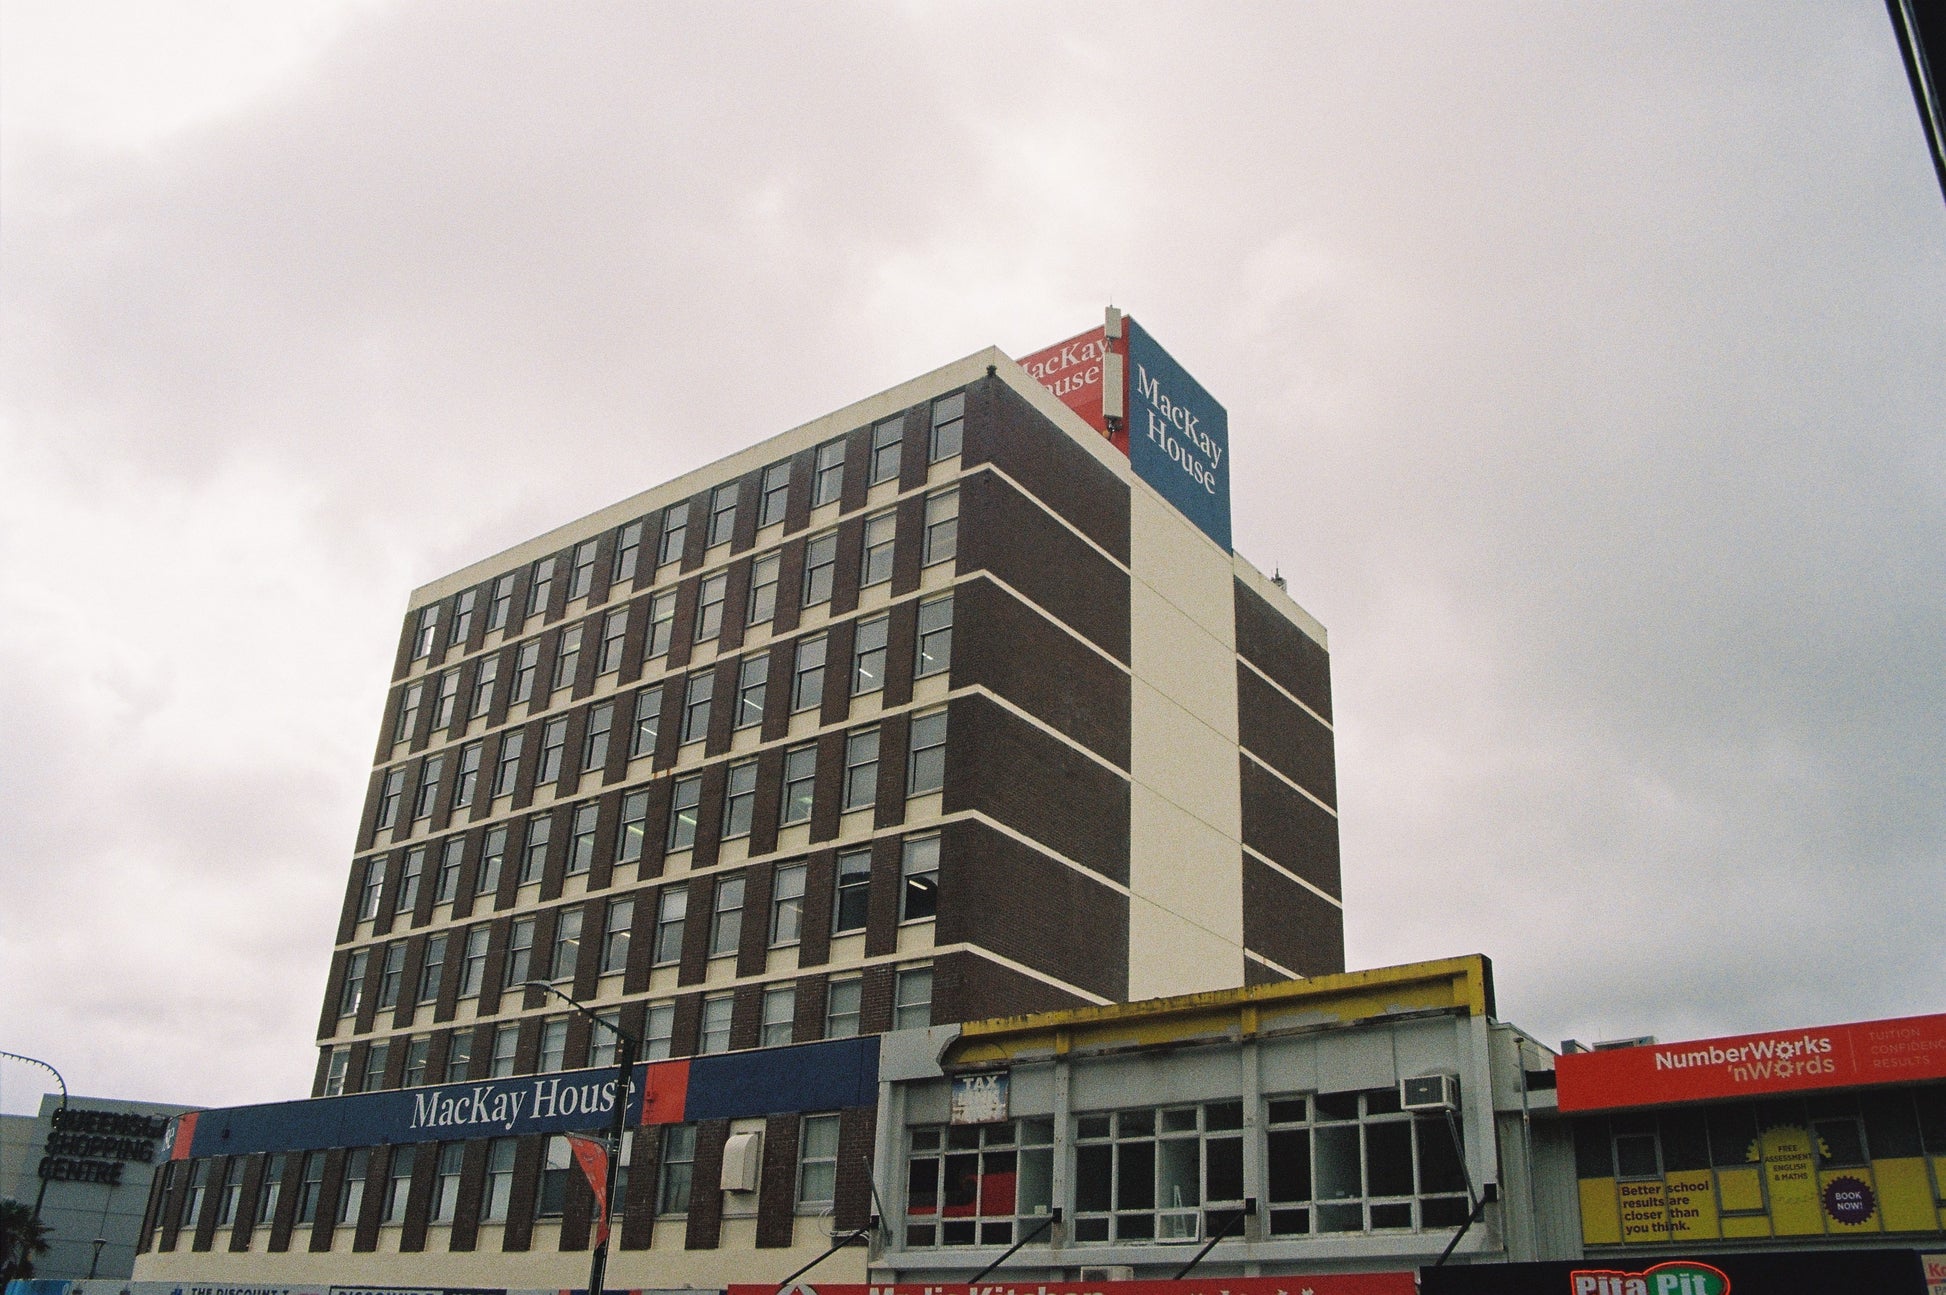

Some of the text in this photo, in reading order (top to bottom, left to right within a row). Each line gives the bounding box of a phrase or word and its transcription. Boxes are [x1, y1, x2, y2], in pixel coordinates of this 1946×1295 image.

[1137, 363, 1222, 469] MacKay
[1147, 408, 1215, 494] House
[1655, 1035, 1832, 1070] NumberWorks
[1873, 1056, 1930, 1068] RESULTS
[963, 1075, 998, 1091] TAX
[409, 1086, 527, 1130] MacKay
[45, 1131, 155, 1163] SHOPPING
[1778, 1144, 1799, 1152] FREE
[38, 1156, 125, 1187] CENTRE
[1773, 1163, 1807, 1172] ENGLISH
[1782, 1172, 1808, 1180] MATHS
[1622, 1181, 1709, 1196] Better school
[1835, 1191, 1862, 1200] BOOK
[1623, 1196, 1690, 1208] results are
[1837, 1202, 1863, 1211] NOW!
[1624, 1208, 1699, 1221] closer than
[1626, 1220, 1690, 1235] you think.
[1575, 1273, 1706, 1295] Pita Pit
